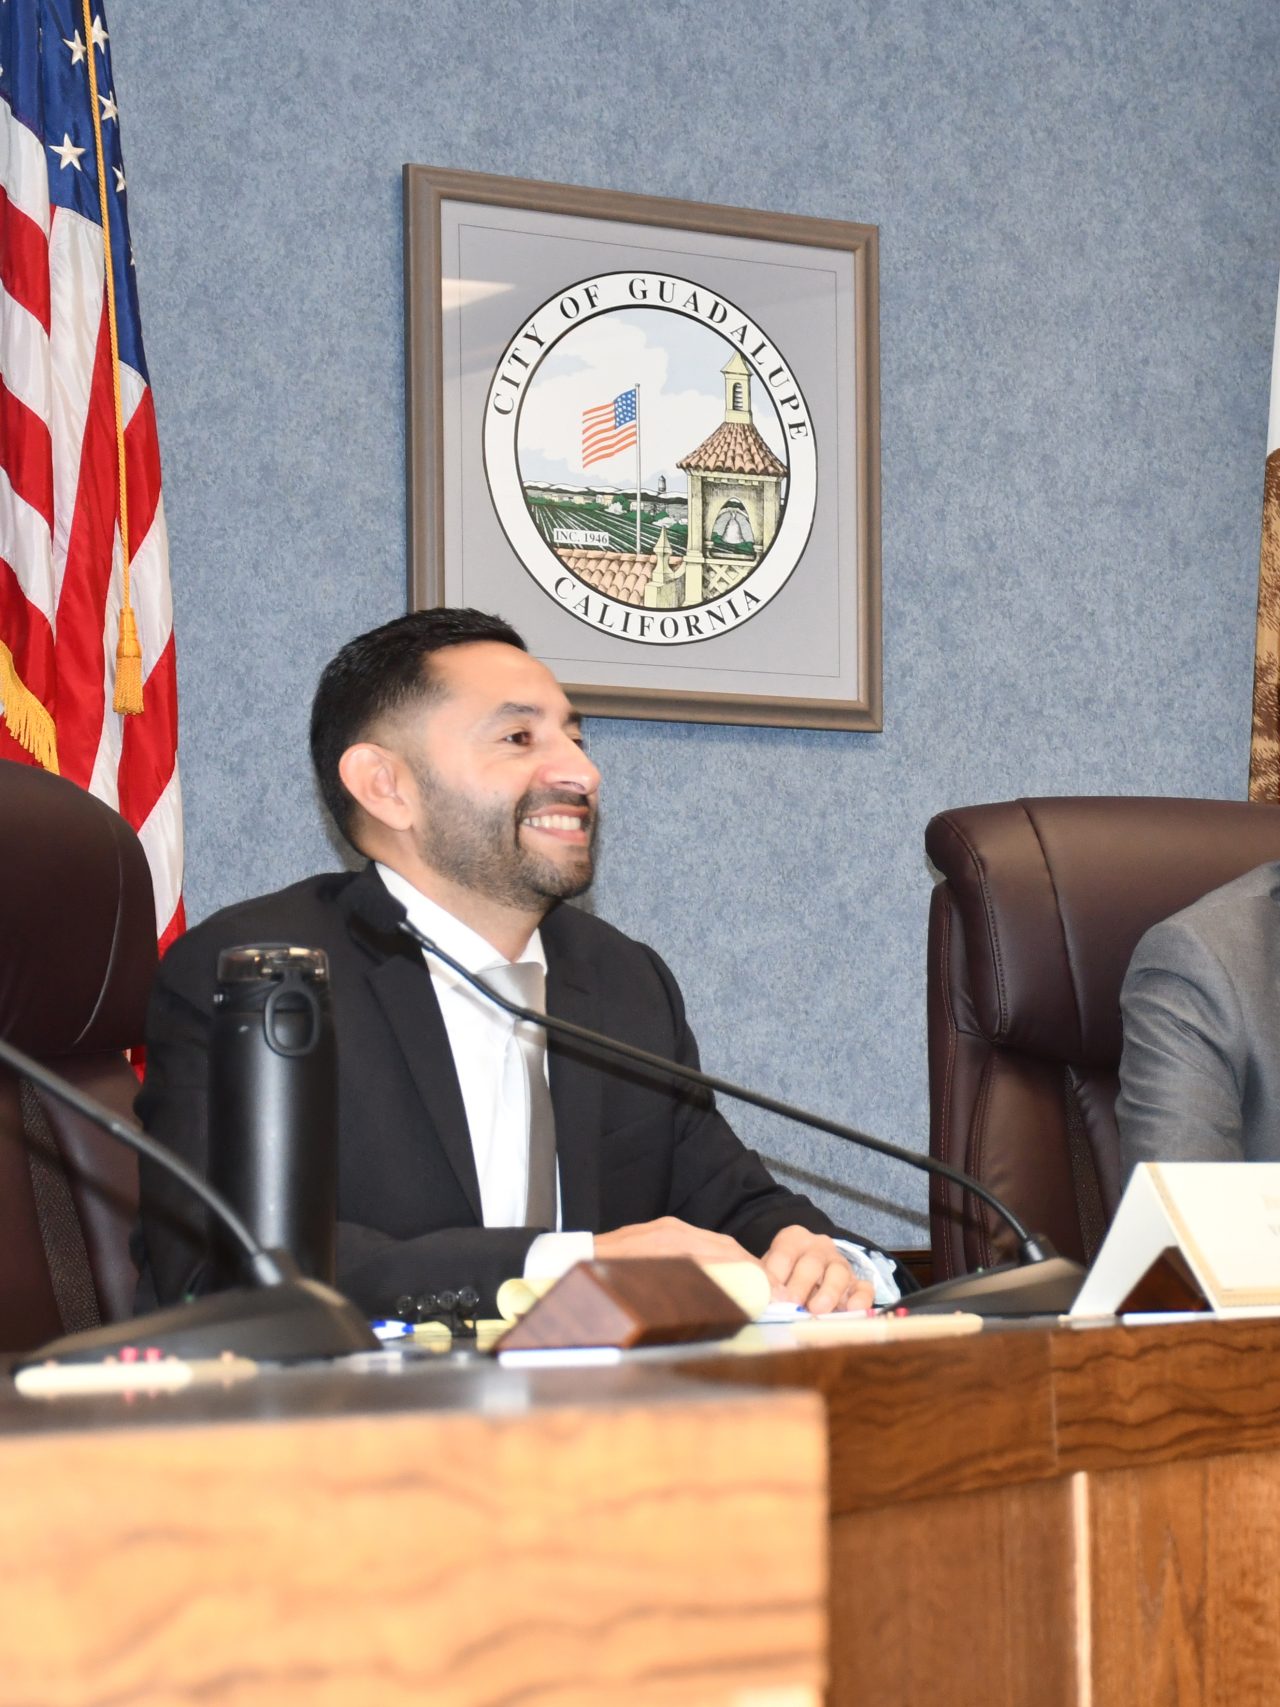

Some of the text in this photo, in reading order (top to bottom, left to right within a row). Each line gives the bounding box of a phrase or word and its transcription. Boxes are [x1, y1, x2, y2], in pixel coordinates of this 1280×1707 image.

[493, 277, 809, 440] CITY OF GUADALUPE
[556, 530, 608, 544] INC. 1946
[554, 576, 762, 638] CALIFORNIA
